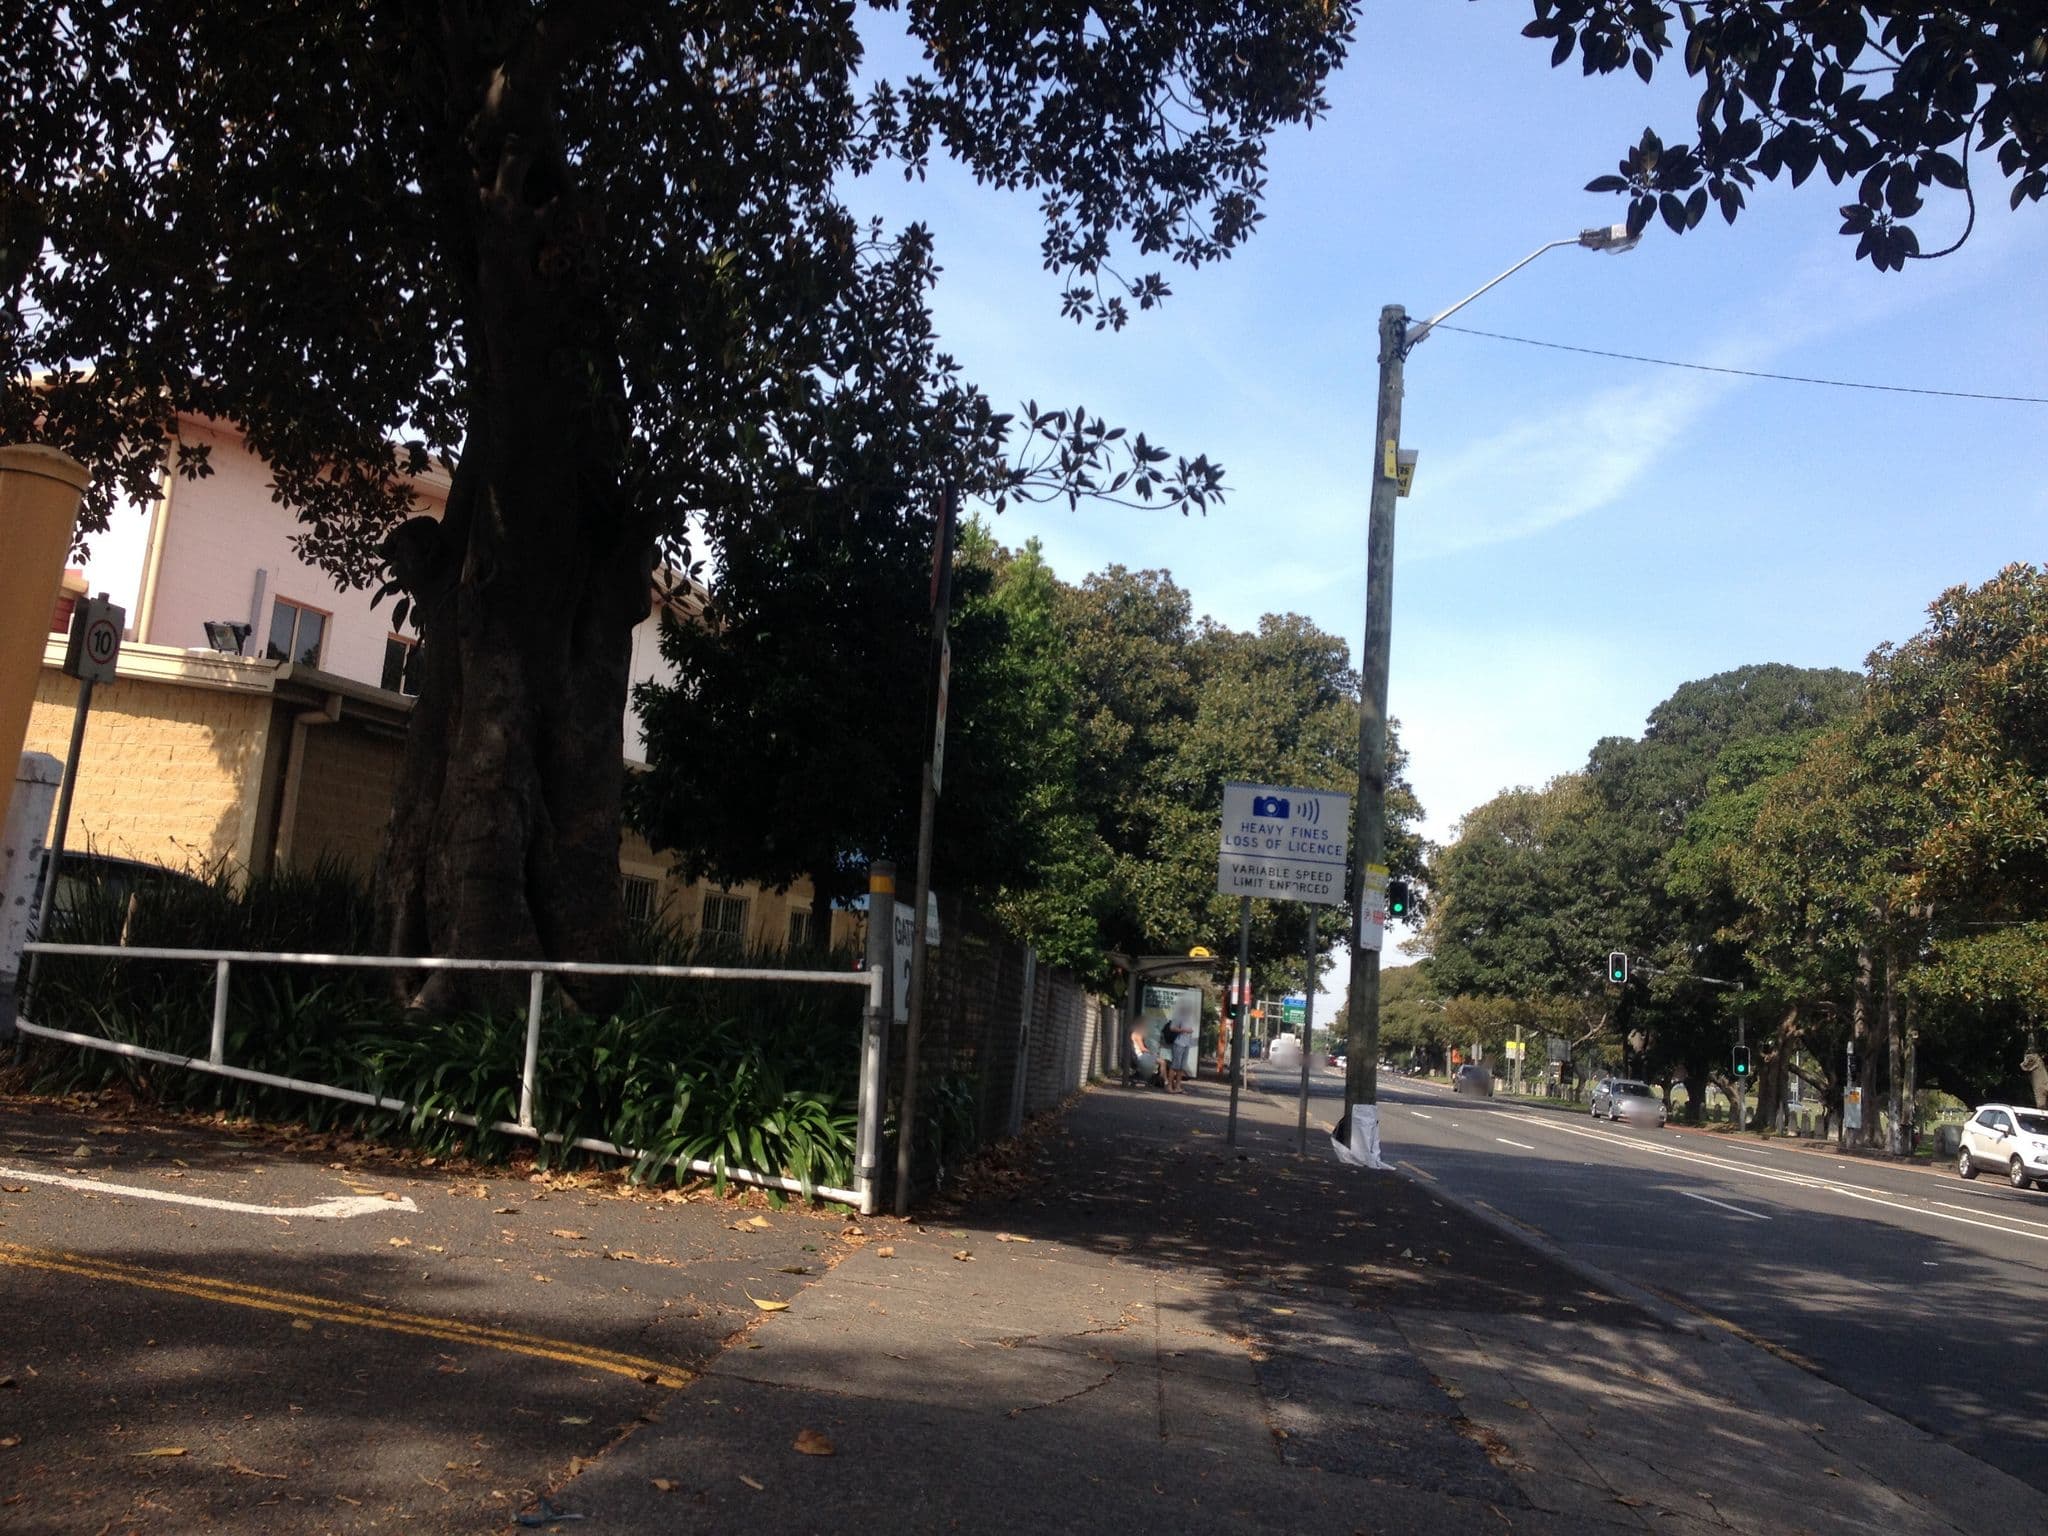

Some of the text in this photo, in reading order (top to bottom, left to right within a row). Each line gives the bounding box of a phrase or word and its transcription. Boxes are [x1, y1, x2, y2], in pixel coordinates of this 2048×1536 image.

[95, 630, 112, 654] 10
[1241, 822, 1329, 840] HEAVY FINES
[1225, 835, 1343, 856] LOSS OF LICENCE
[1232, 864, 1333, 882] VARIABLE SPEED
[1233, 877, 1264, 888] LIMIT
